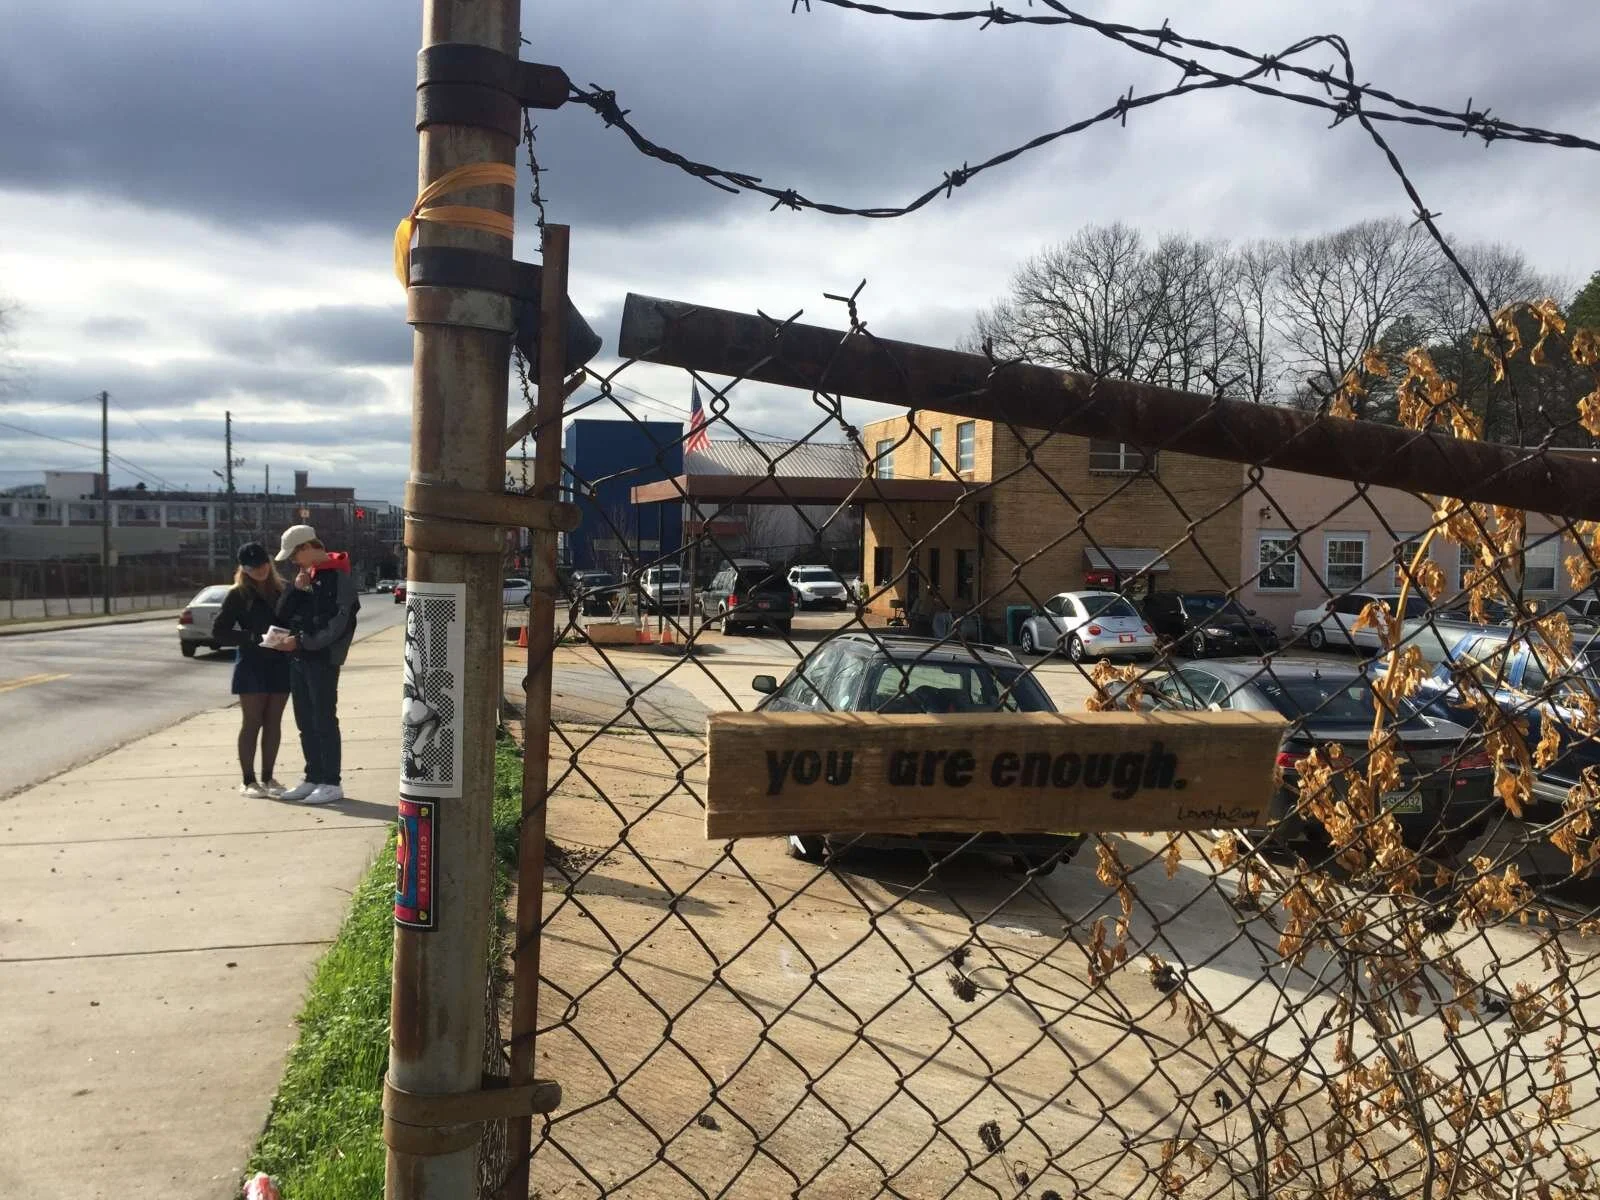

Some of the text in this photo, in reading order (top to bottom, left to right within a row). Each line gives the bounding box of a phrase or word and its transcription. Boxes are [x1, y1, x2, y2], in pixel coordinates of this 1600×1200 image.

[765, 741, 1187, 800] you are enough.
